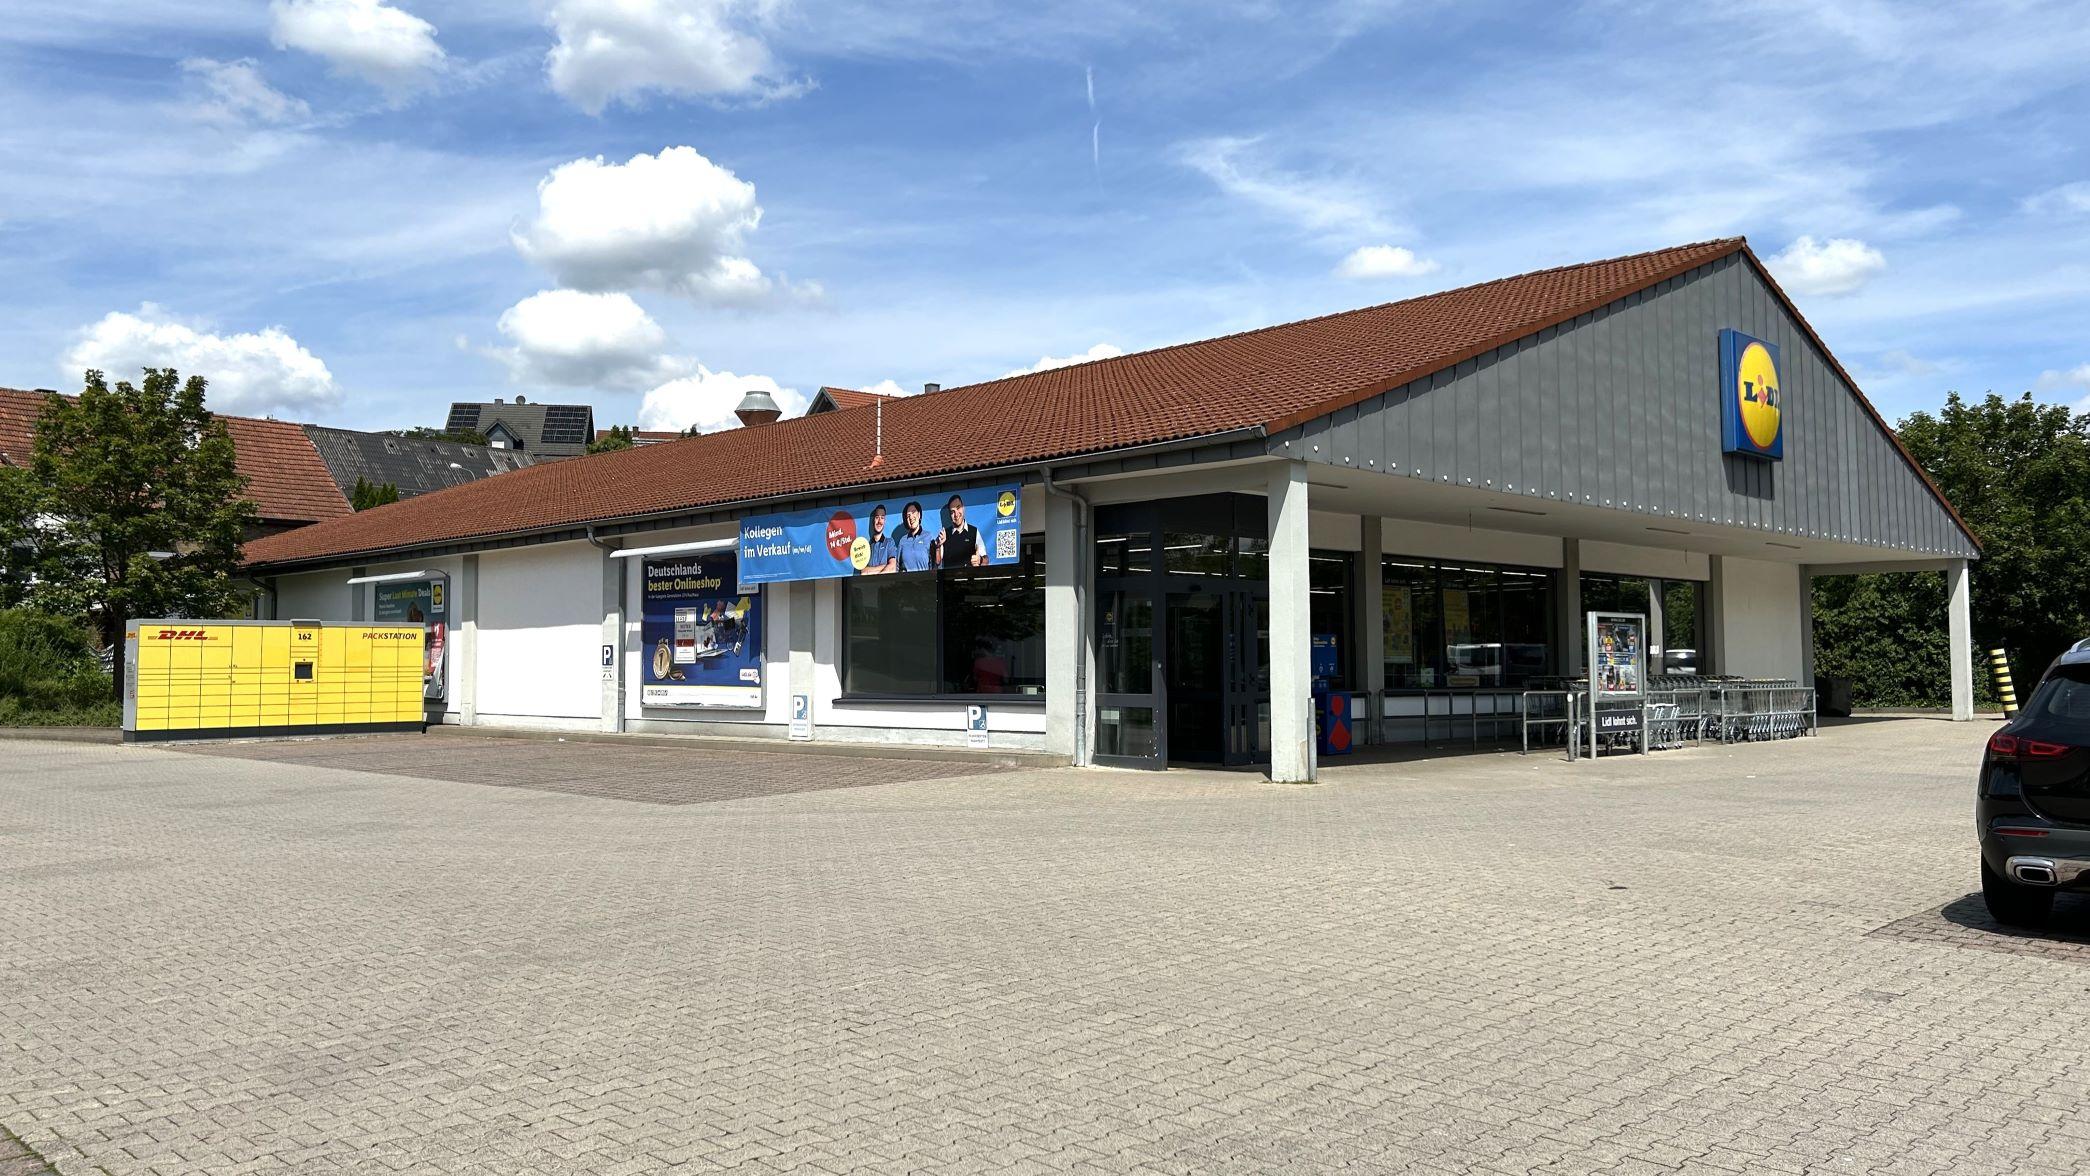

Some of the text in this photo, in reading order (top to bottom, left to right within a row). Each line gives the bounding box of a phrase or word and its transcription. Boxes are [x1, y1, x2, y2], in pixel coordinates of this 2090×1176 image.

[744, 526, 782, 541] Kollegen
[744, 541, 812, 558] im Verkauf (m/w/d)
[829, 541, 836, 549] 14
[647, 562, 703, 578] Deutschlands
[647, 579, 673, 592] bester
[379, 592, 392, 601] Super
[417, 588, 431, 598] Deals
[158, 630, 208, 640] DHL
[362, 632, 418, 640] PACKSTATION
[603, 646, 612, 665] P
[793, 696, 805, 719] P
[968, 706, 982, 730] P
[1601, 716, 1612, 727] Lidl
[1612, 716, 1626, 726] lohnt
